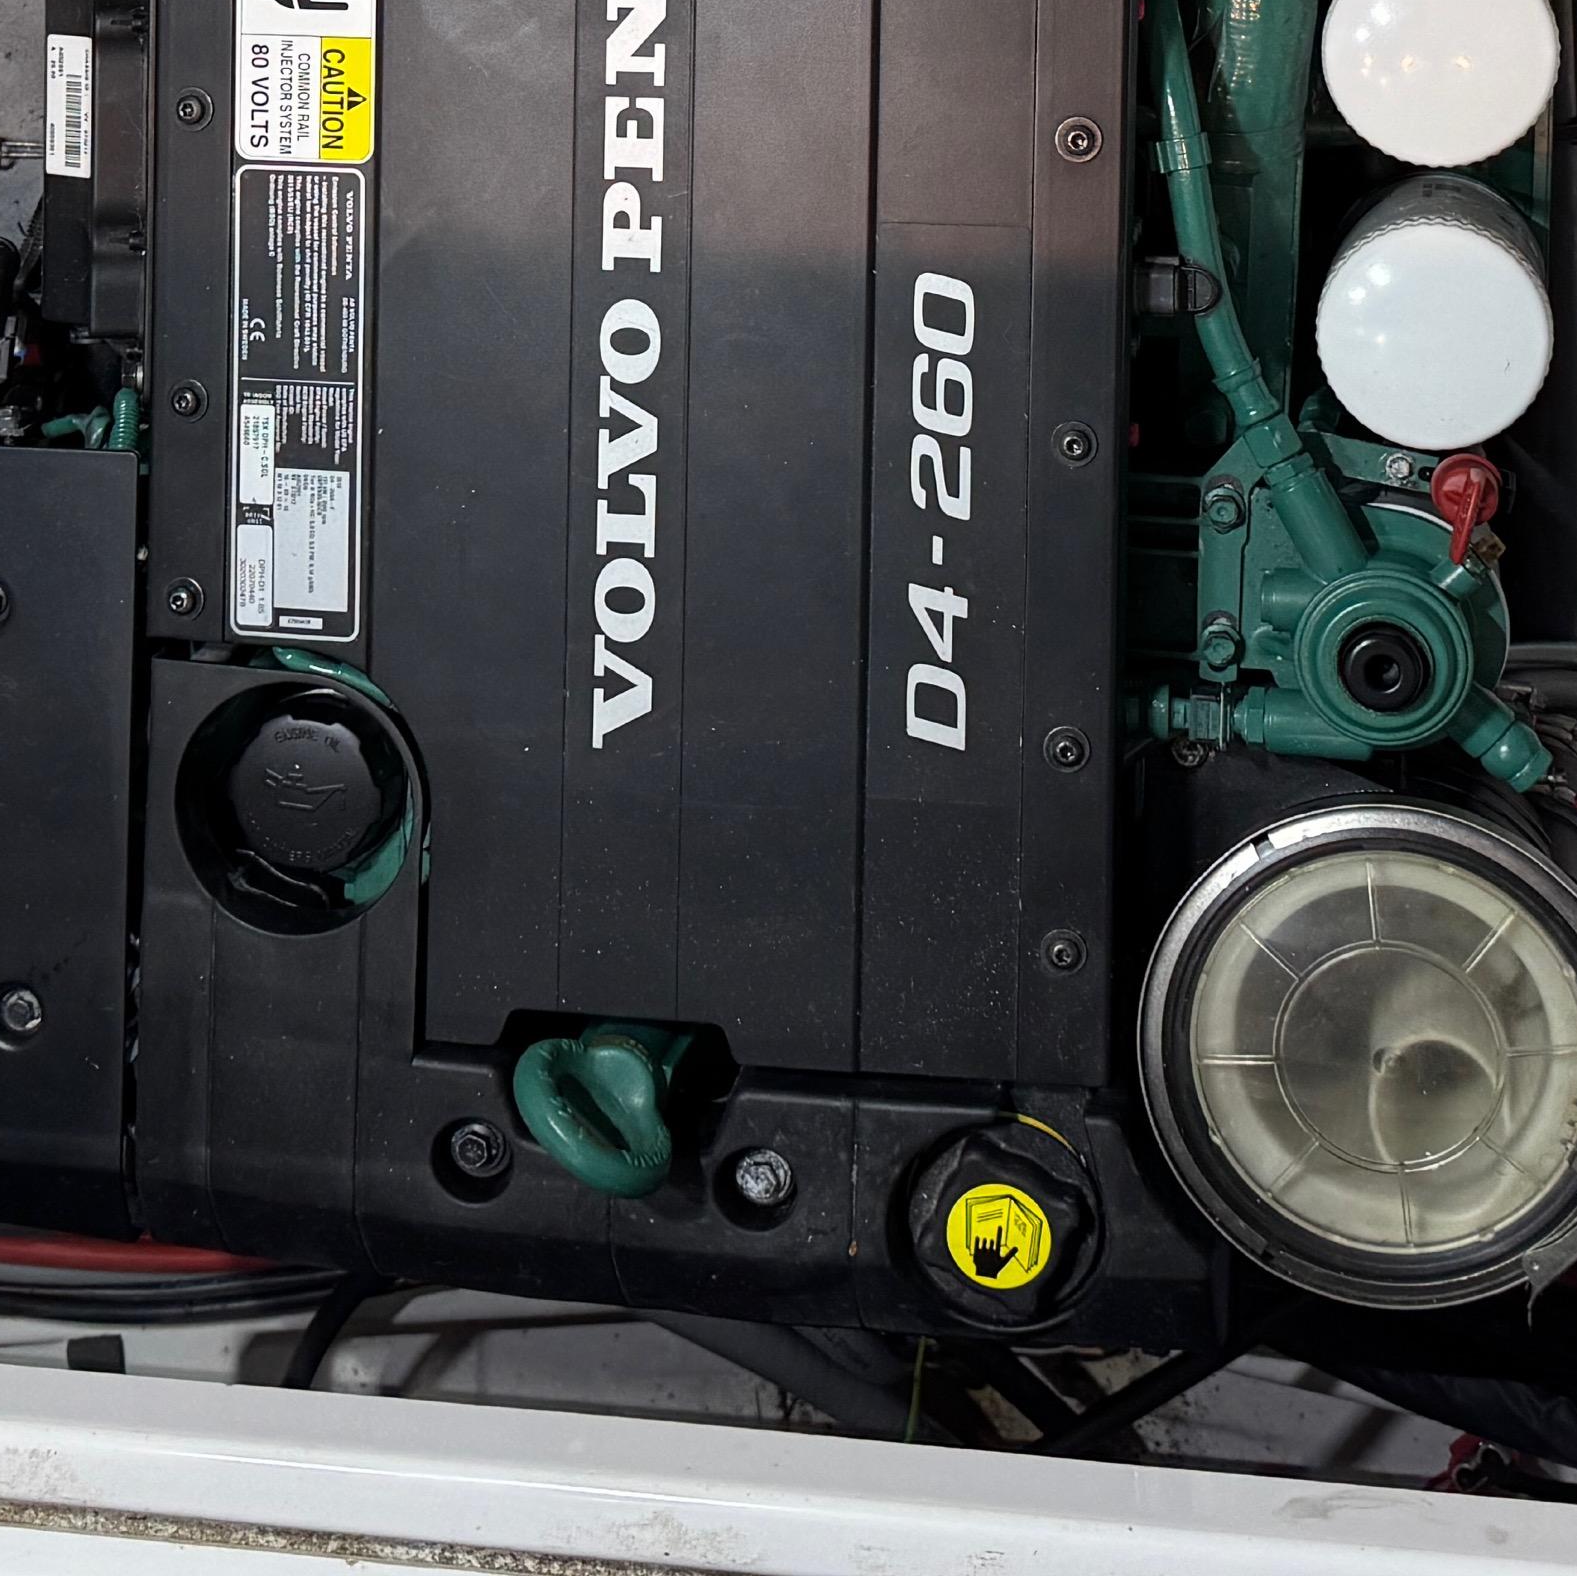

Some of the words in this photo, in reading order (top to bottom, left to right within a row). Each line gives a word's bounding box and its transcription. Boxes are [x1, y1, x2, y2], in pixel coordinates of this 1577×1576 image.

[251, 44, 269, 68] 80
[280, 40, 293, 101] INJECTOR
[297, 53, 310, 110] COMMON
[250, 77, 269, 148] VOLTS
[322, 48, 346, 150] CAUTION
[279, 105, 292, 155] SYSTEM
[297, 114, 309, 141] RAIL
[345, 191, 353, 233] VOLVO
[345, 236, 353, 280] PENTA
[249, 318, 266, 342] CE
[590, 297, 663, 751] VOLVO
[904, 270, 976, 753] D4-260
